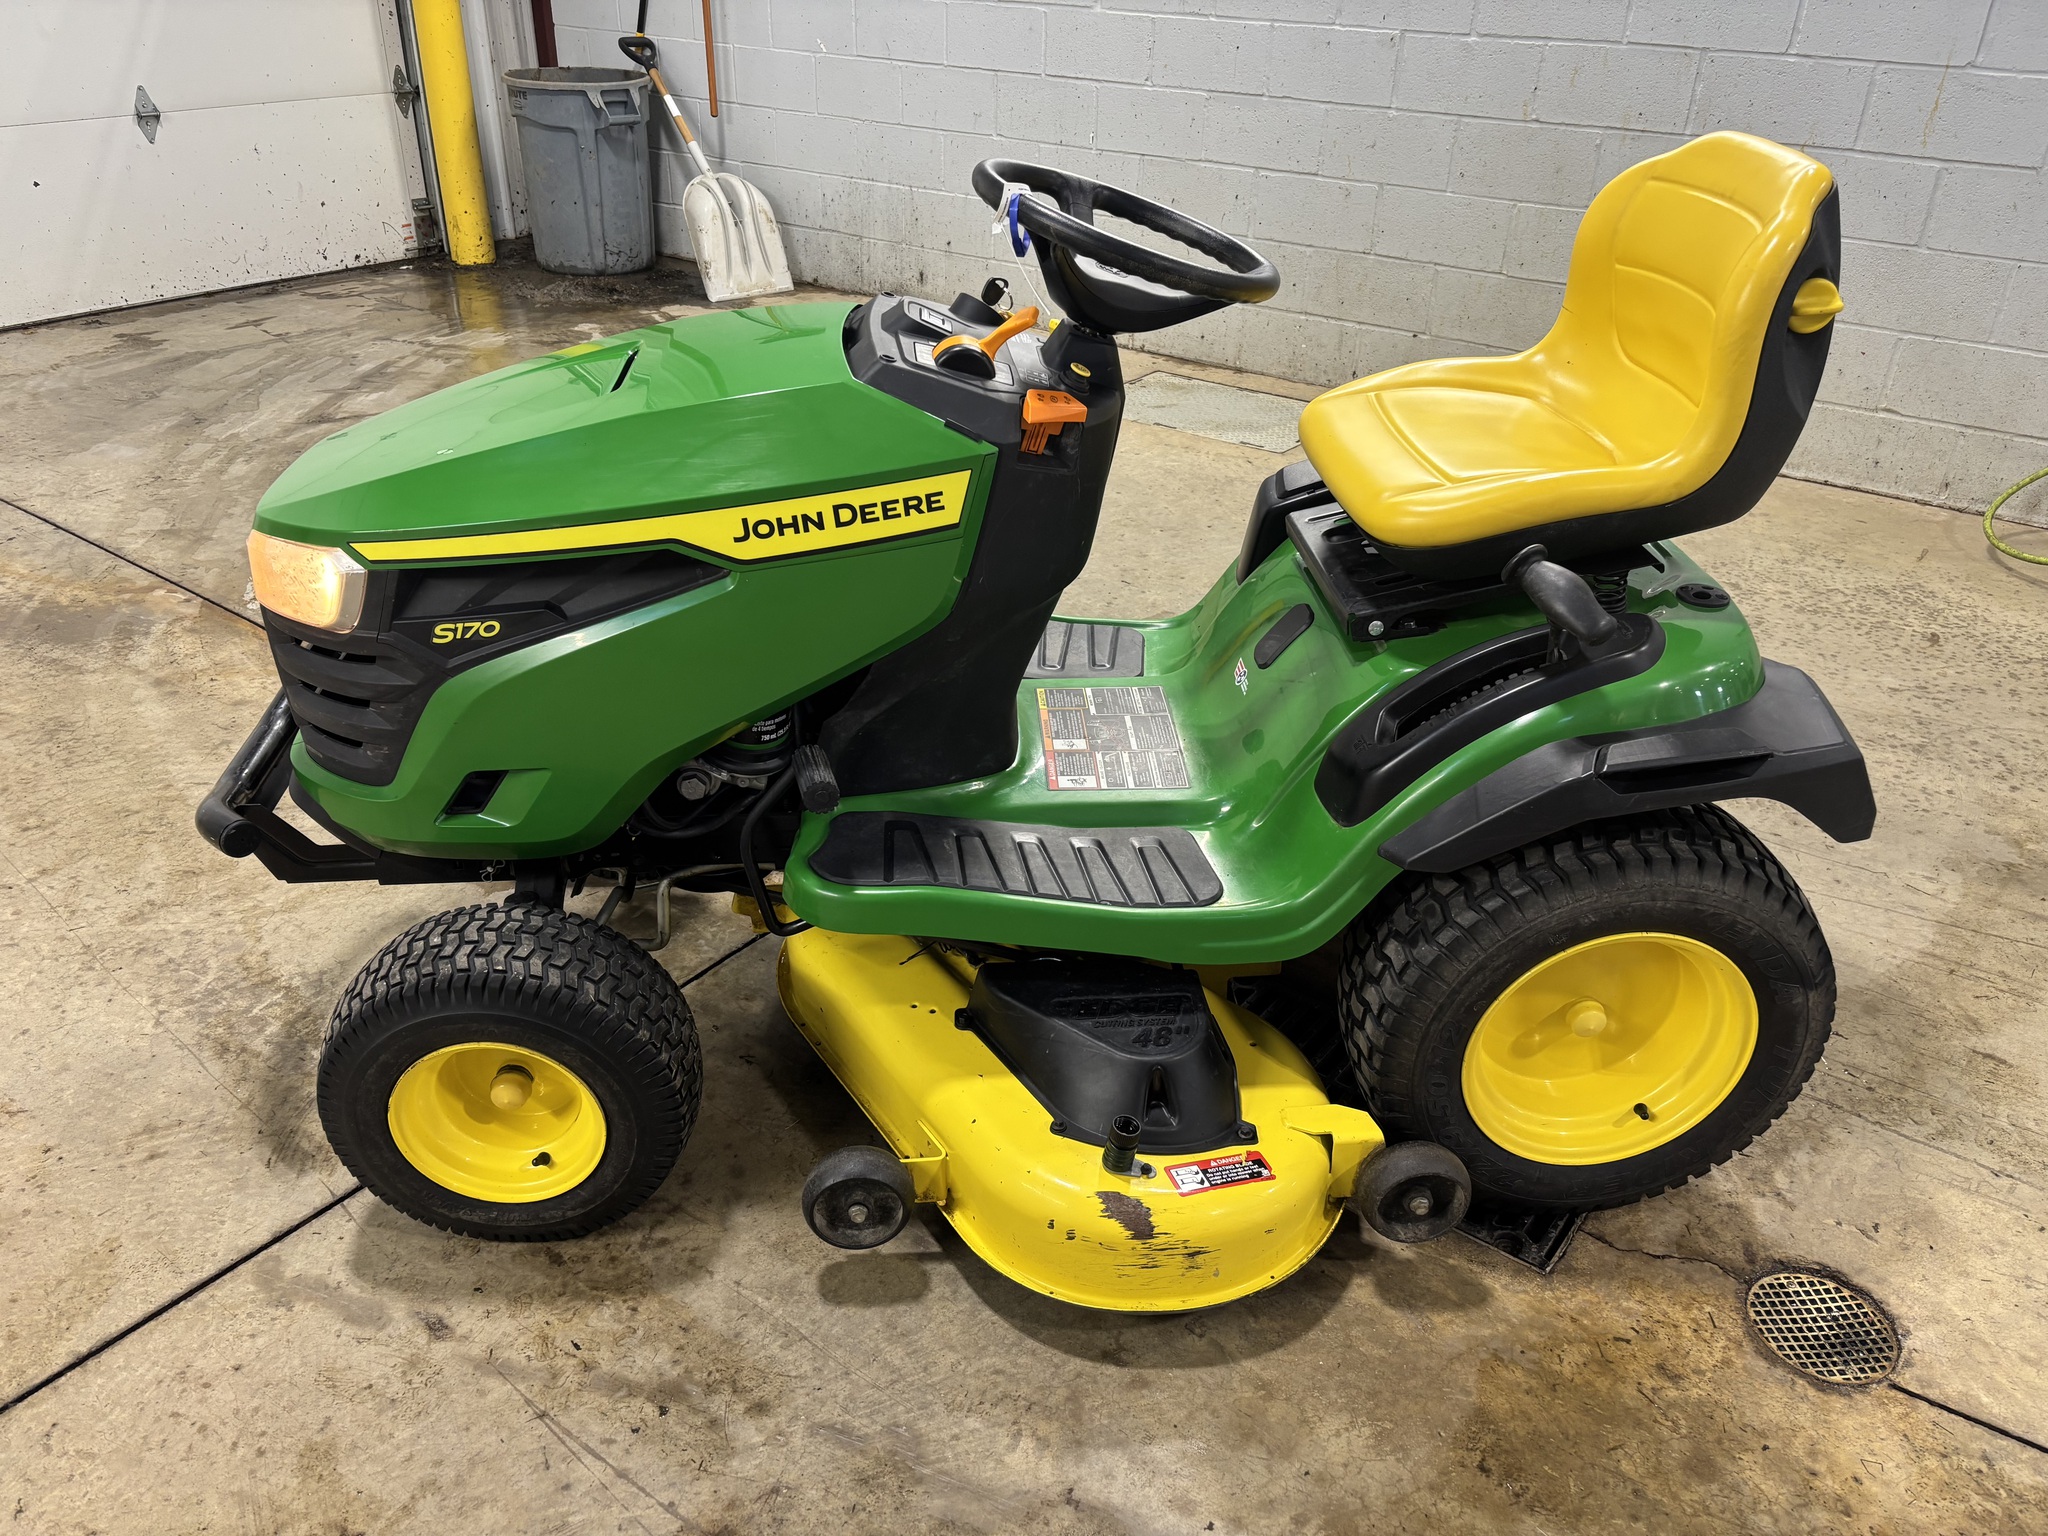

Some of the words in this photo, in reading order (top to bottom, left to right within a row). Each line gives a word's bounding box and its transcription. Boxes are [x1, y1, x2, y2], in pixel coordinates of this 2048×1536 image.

[733, 511, 825, 543] JOHN
[832, 491, 945, 529] DEERE
[432, 620, 501, 644] S170
[1047, 759, 1055, 777] DANGER
[1216, 1155, 1243, 1165] DANGE
